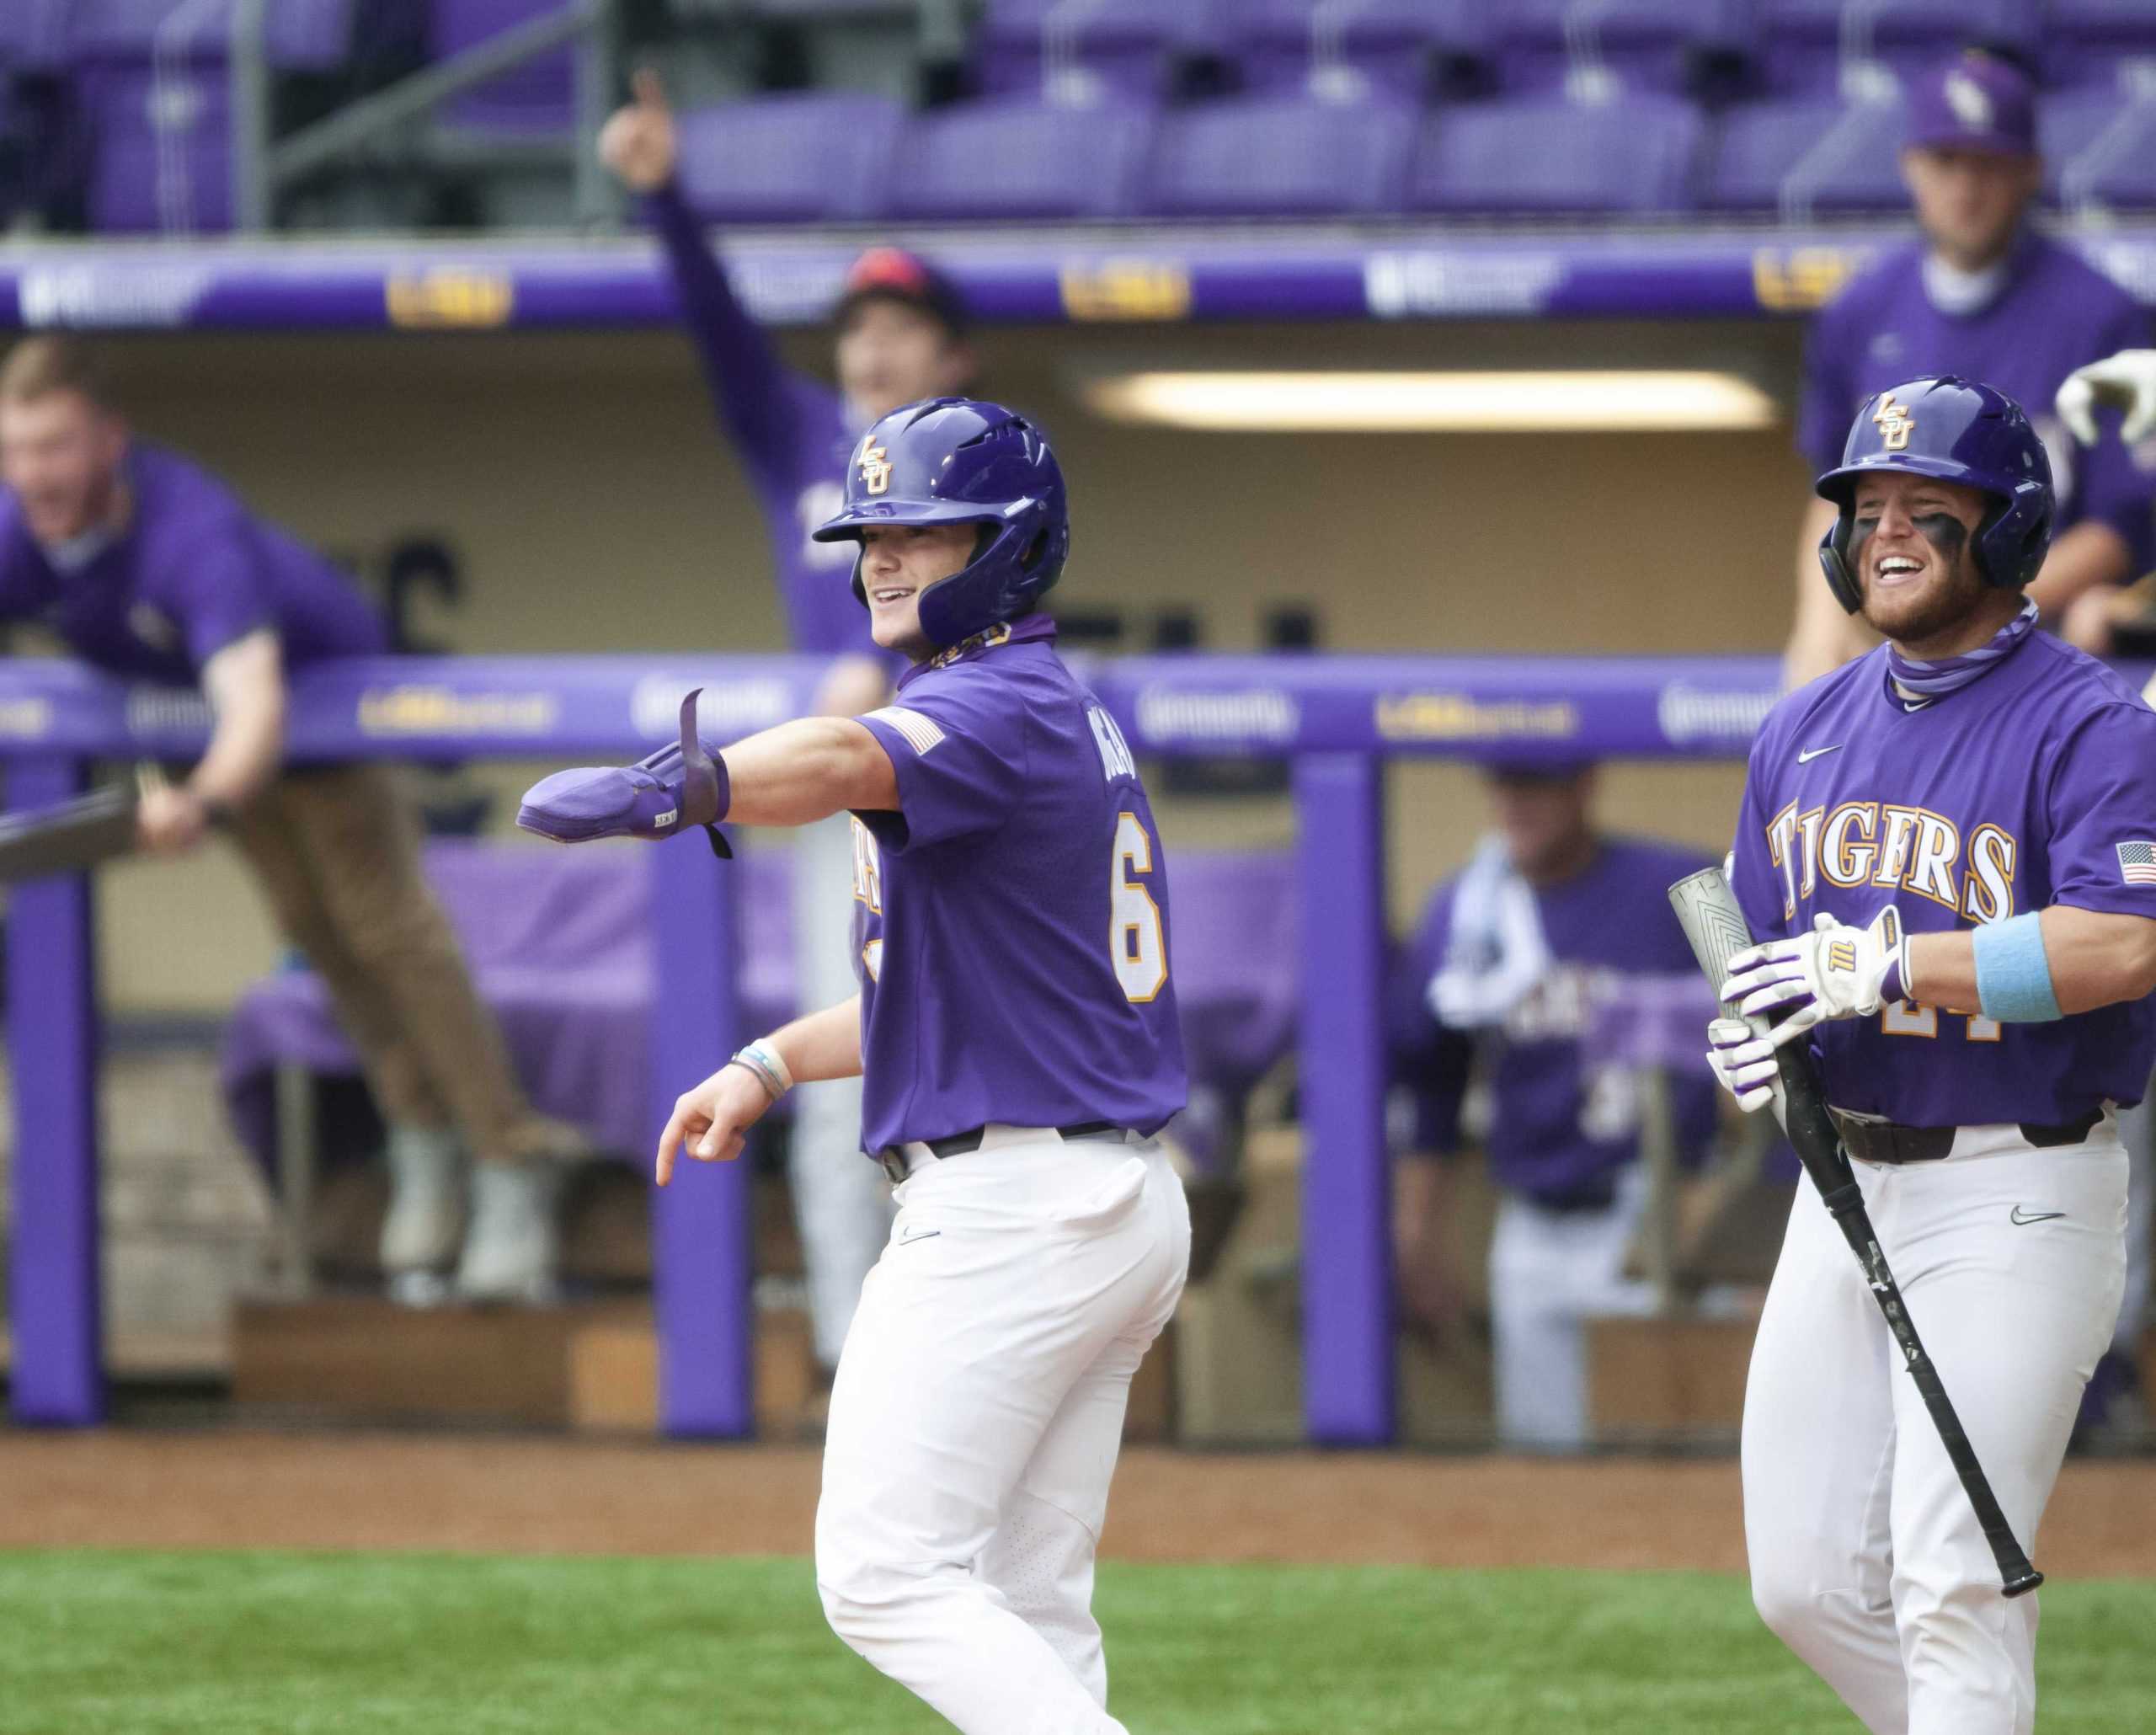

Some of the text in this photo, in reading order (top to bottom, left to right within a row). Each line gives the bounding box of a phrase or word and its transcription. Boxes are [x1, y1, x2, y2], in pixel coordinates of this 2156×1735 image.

[857, 435, 893, 495] LSU
[1872, 394, 1914, 451] LSU
[1109, 811, 1168, 1003] 6
[1766, 797, 2016, 925] TIGERS
